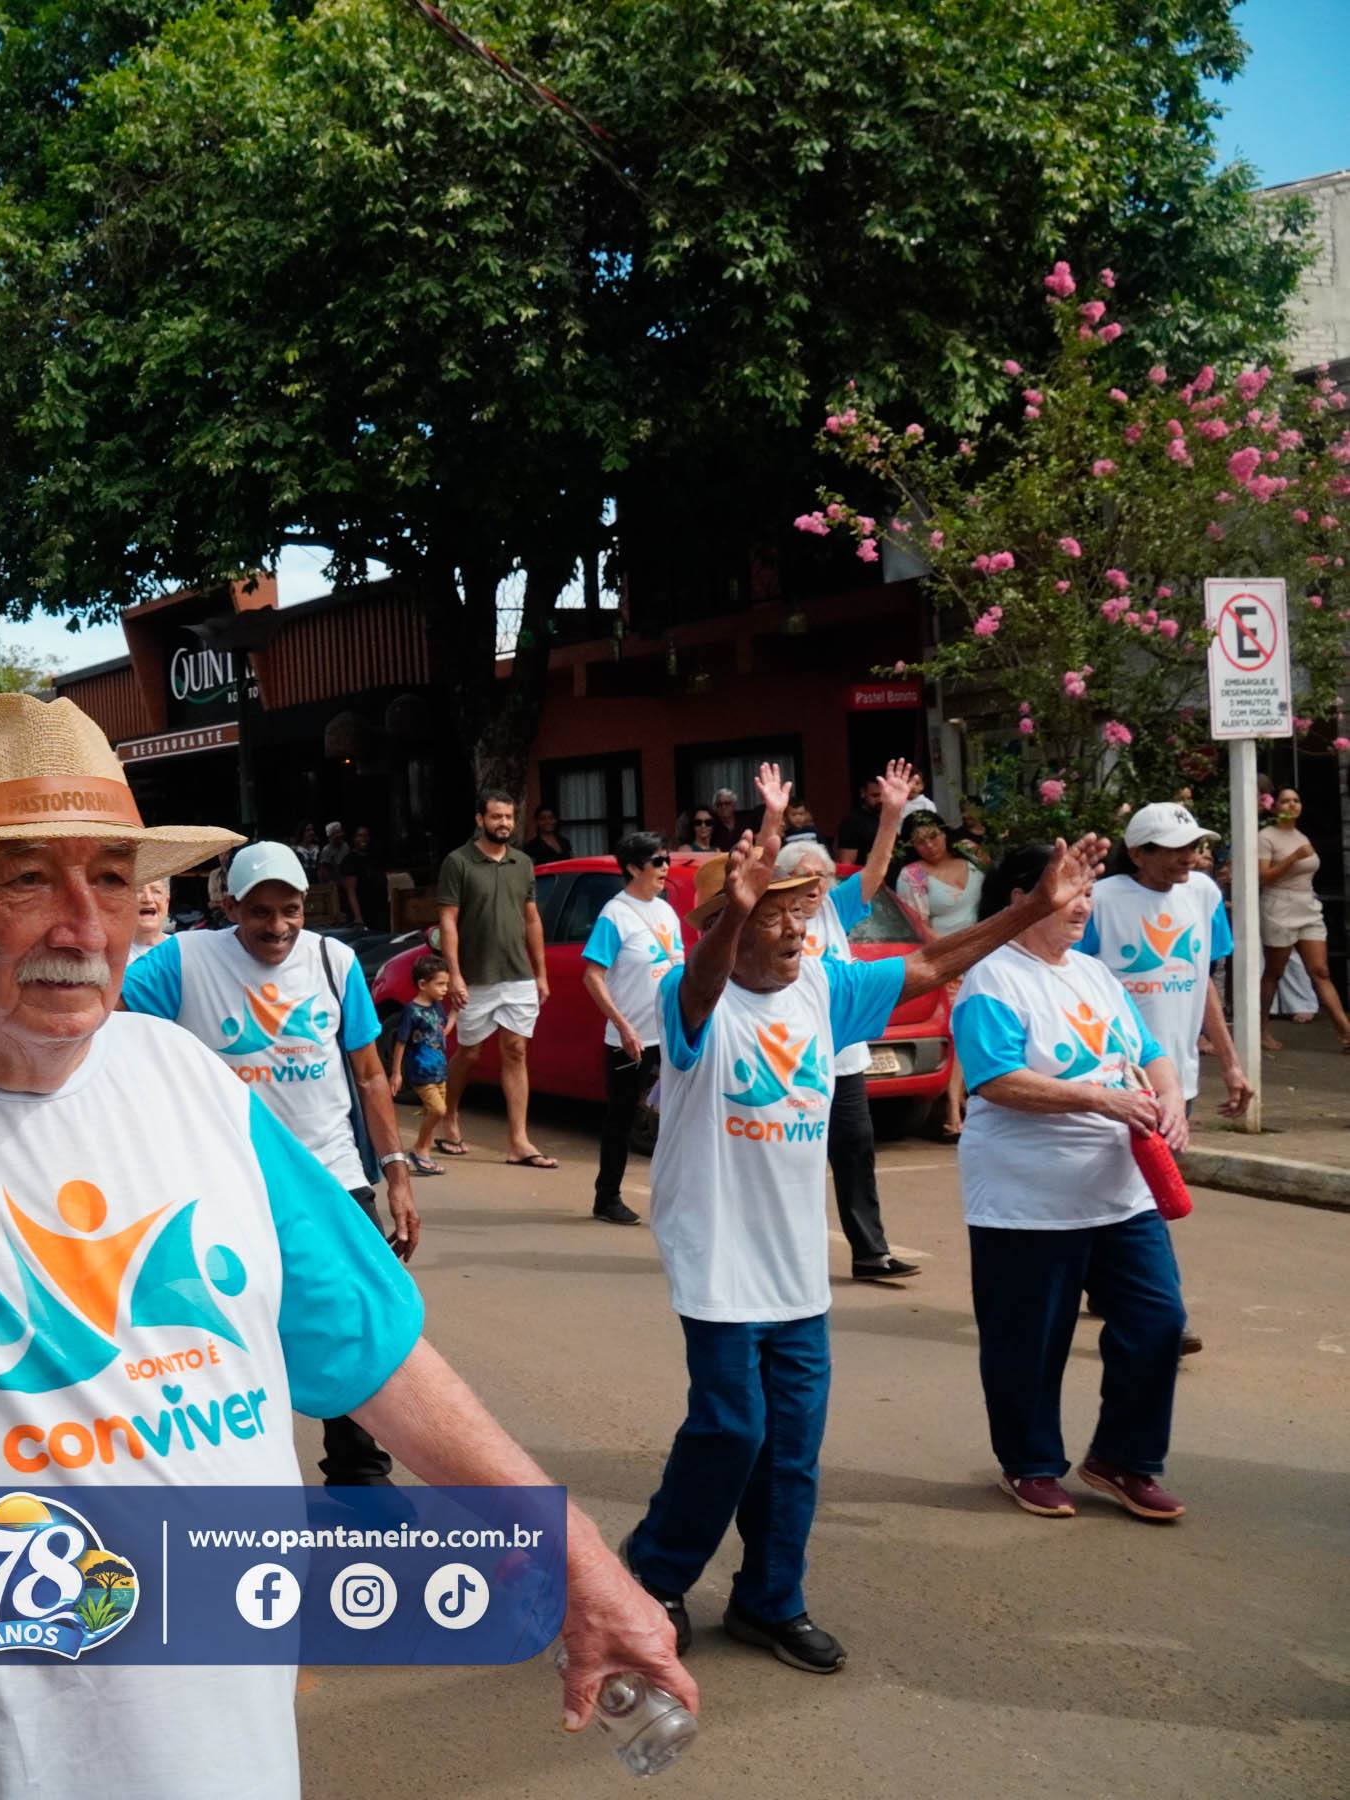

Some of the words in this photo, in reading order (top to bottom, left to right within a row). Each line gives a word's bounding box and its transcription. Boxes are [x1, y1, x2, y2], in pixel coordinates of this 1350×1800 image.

[132, 730, 222, 757] RESTAURANTE
[231, 1057, 328, 1083] onviver
[125, 1348, 203, 1381] BONITO
[3, 1384, 267, 1473] conviver
